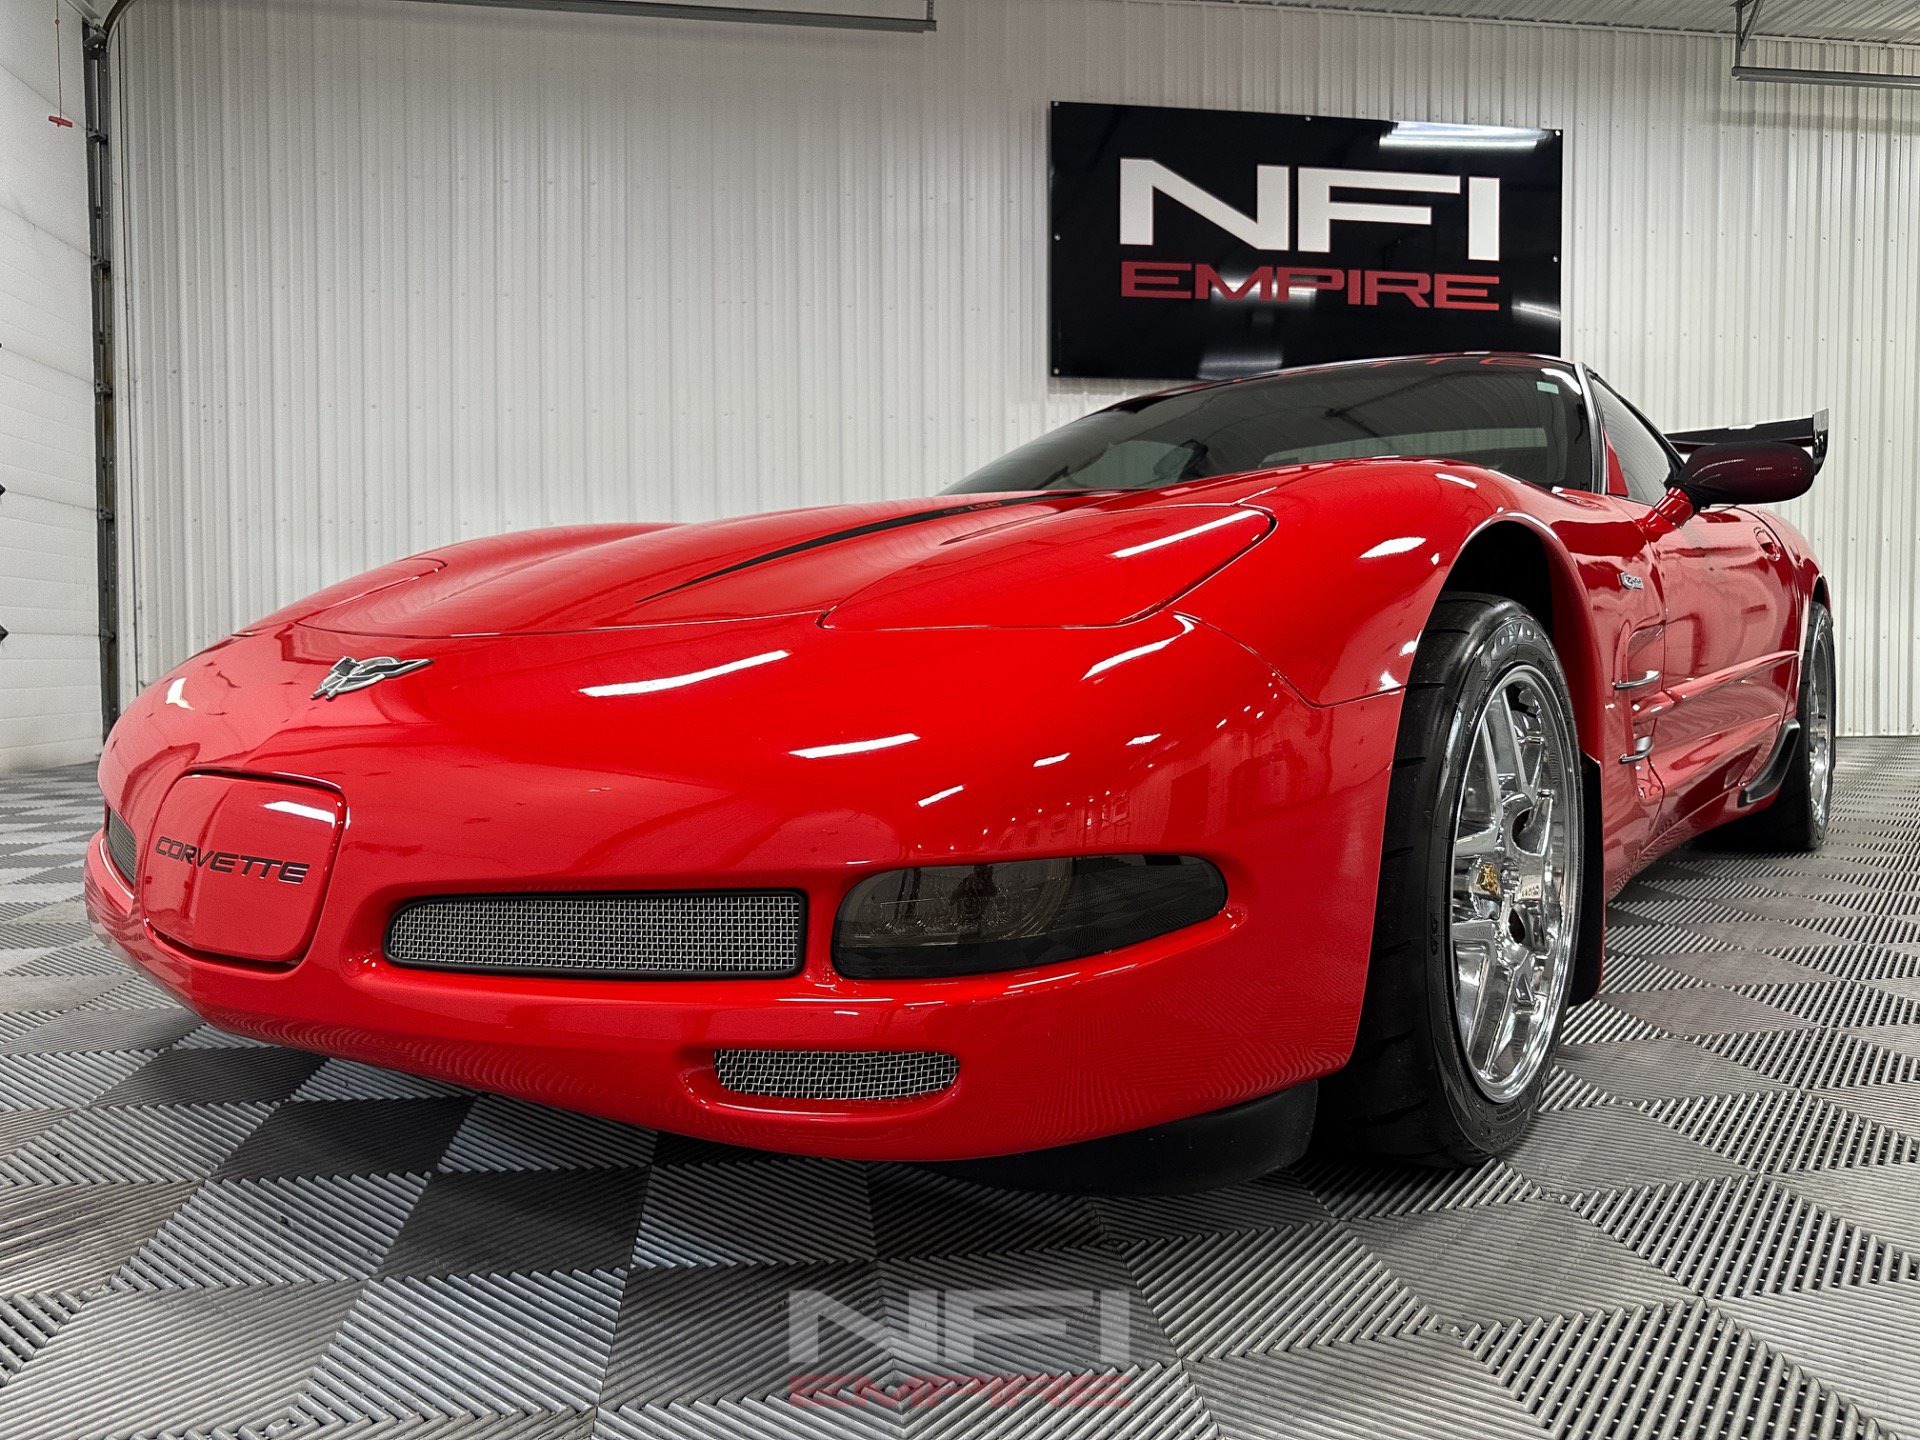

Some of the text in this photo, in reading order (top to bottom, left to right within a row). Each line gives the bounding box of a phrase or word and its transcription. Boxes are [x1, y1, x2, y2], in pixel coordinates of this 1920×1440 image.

[1119, 157, 1500, 261] NFI
[1120, 261, 1500, 311] EMPIRE
[155, 836, 310, 884] CORVETTE
